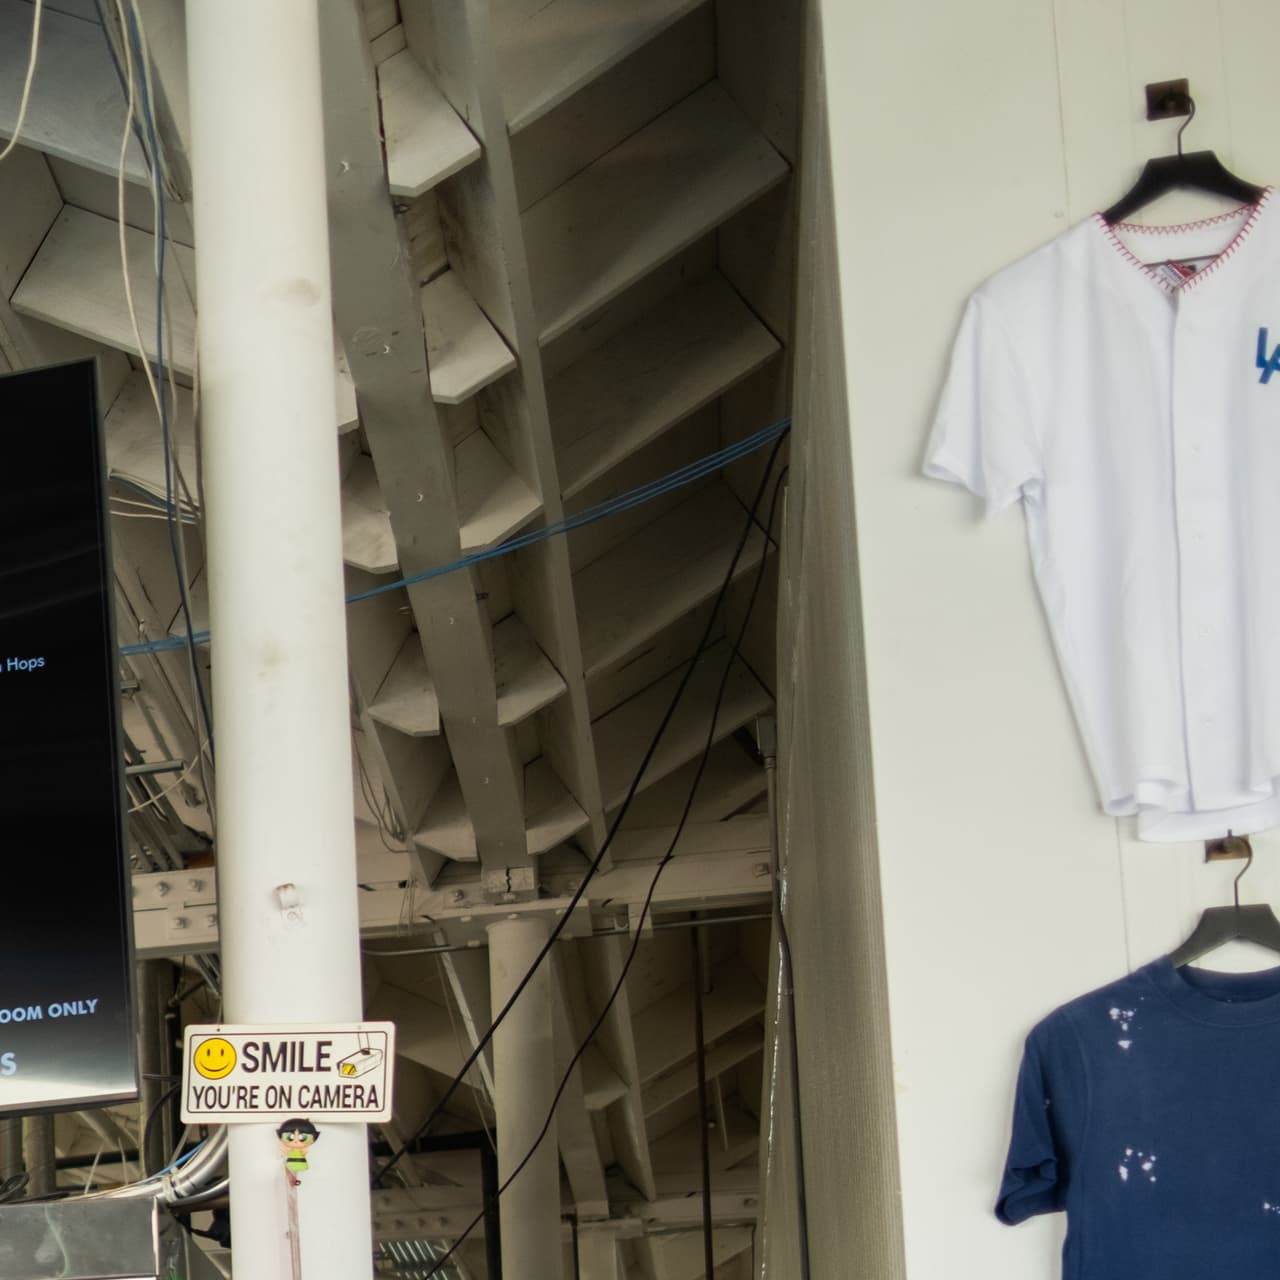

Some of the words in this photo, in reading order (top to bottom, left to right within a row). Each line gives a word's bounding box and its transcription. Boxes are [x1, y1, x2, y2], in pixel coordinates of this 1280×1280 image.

[7, 655, 45, 674] Hops
[241, 1041, 333, 1073] SMILE
[193, 1085, 259, 1109] YOU'RE
[265, 1085, 292, 1109] ON
[298, 1085, 379, 1108] CAMERA
